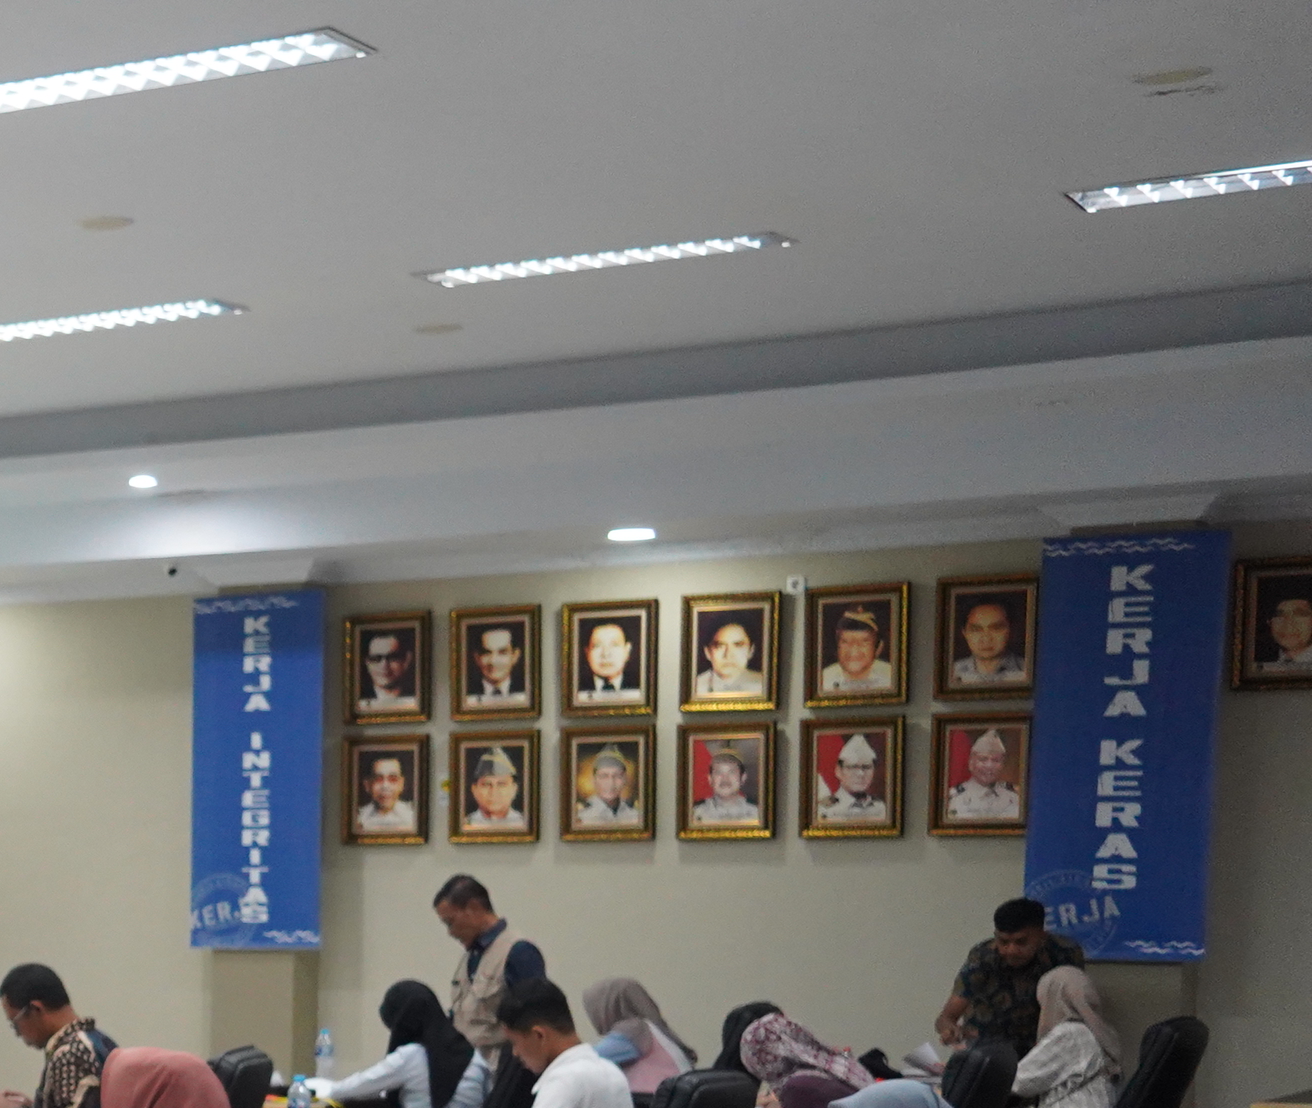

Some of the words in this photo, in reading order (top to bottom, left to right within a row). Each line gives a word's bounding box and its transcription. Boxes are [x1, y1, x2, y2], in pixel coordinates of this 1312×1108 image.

[243, 615, 271, 712] KERJA
[1103, 564, 1156, 718] KERJA
[241, 732, 270, 924] INTEGRITAS
[1091, 739, 1143, 891] KERAS
[1044, 895, 1121, 931] ERJA
